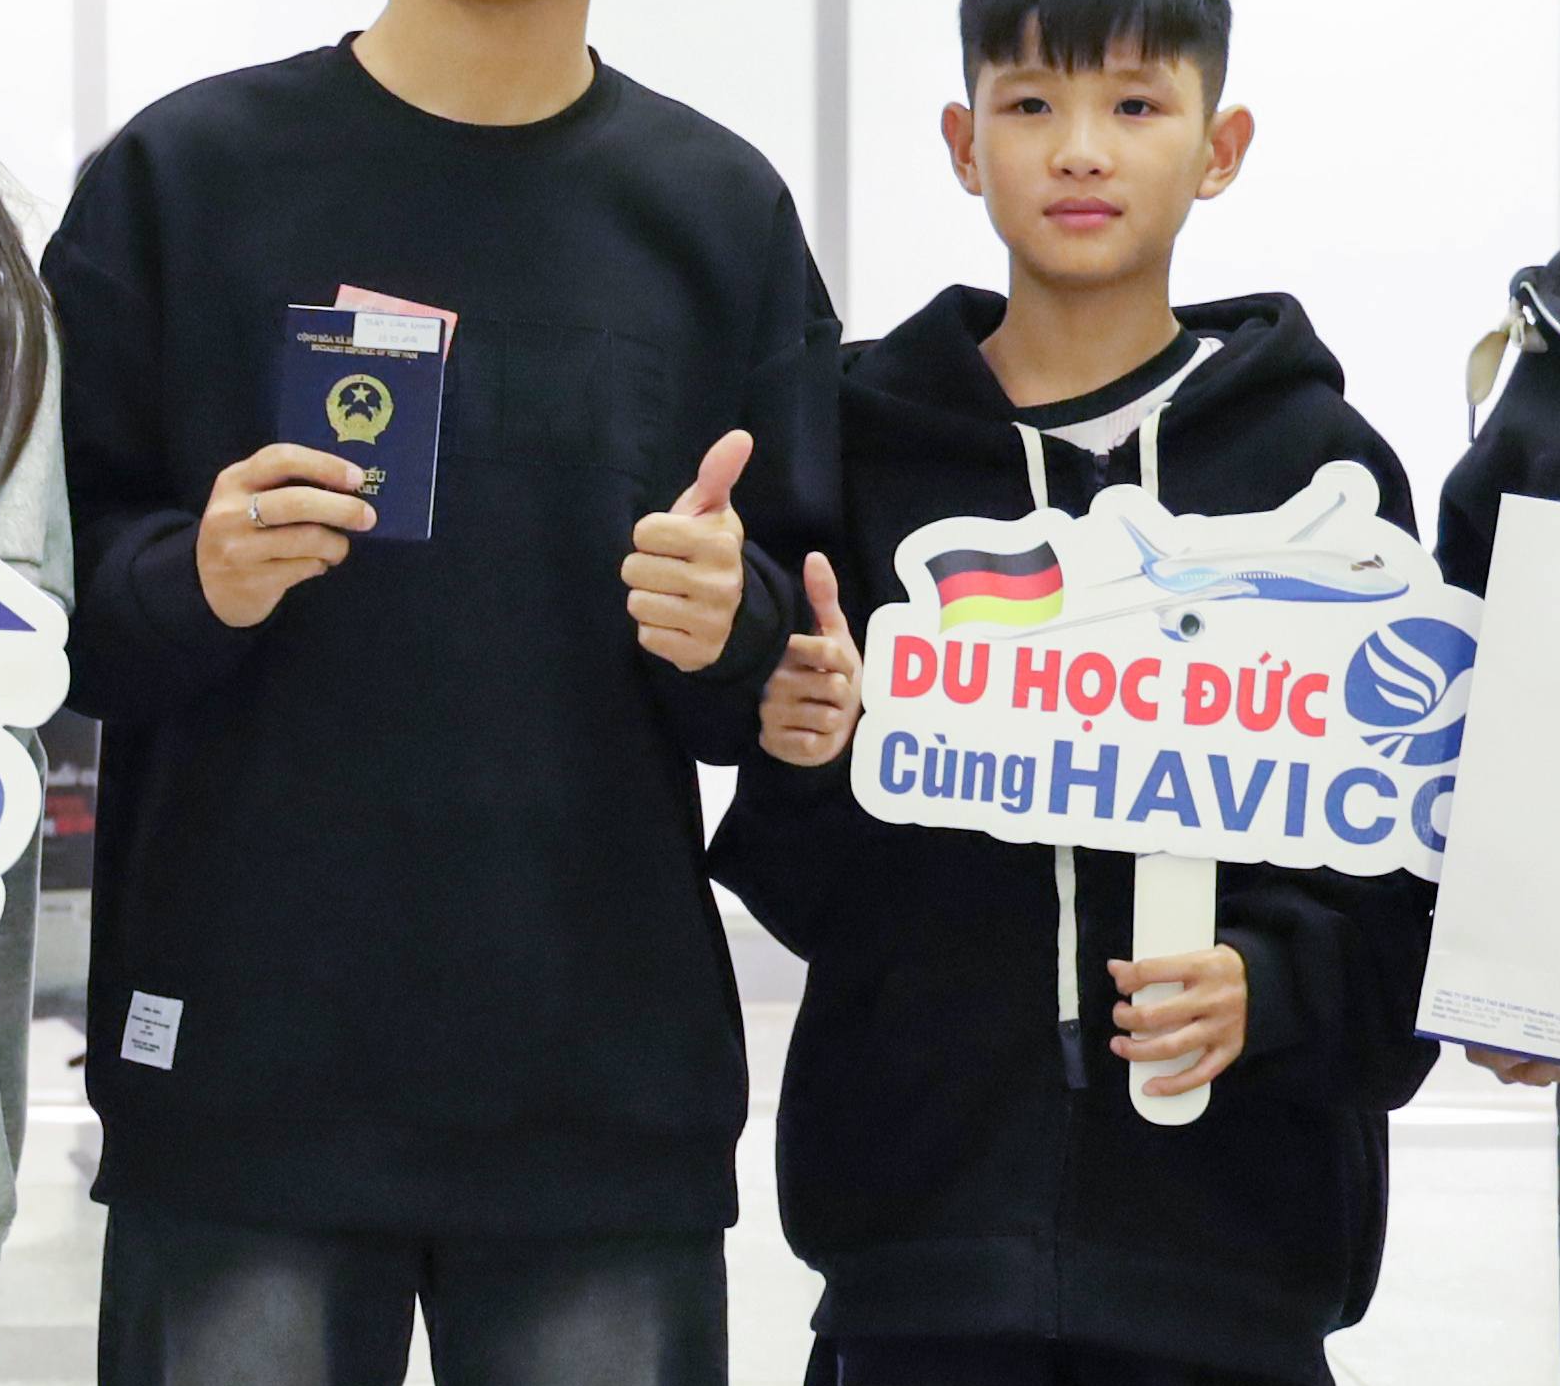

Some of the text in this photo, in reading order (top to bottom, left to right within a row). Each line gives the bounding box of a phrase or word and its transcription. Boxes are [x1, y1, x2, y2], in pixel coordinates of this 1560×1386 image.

[890, 635, 1330, 738] DU HỌC ĐỨC
[878, 730, 1037, 814] Cùng
